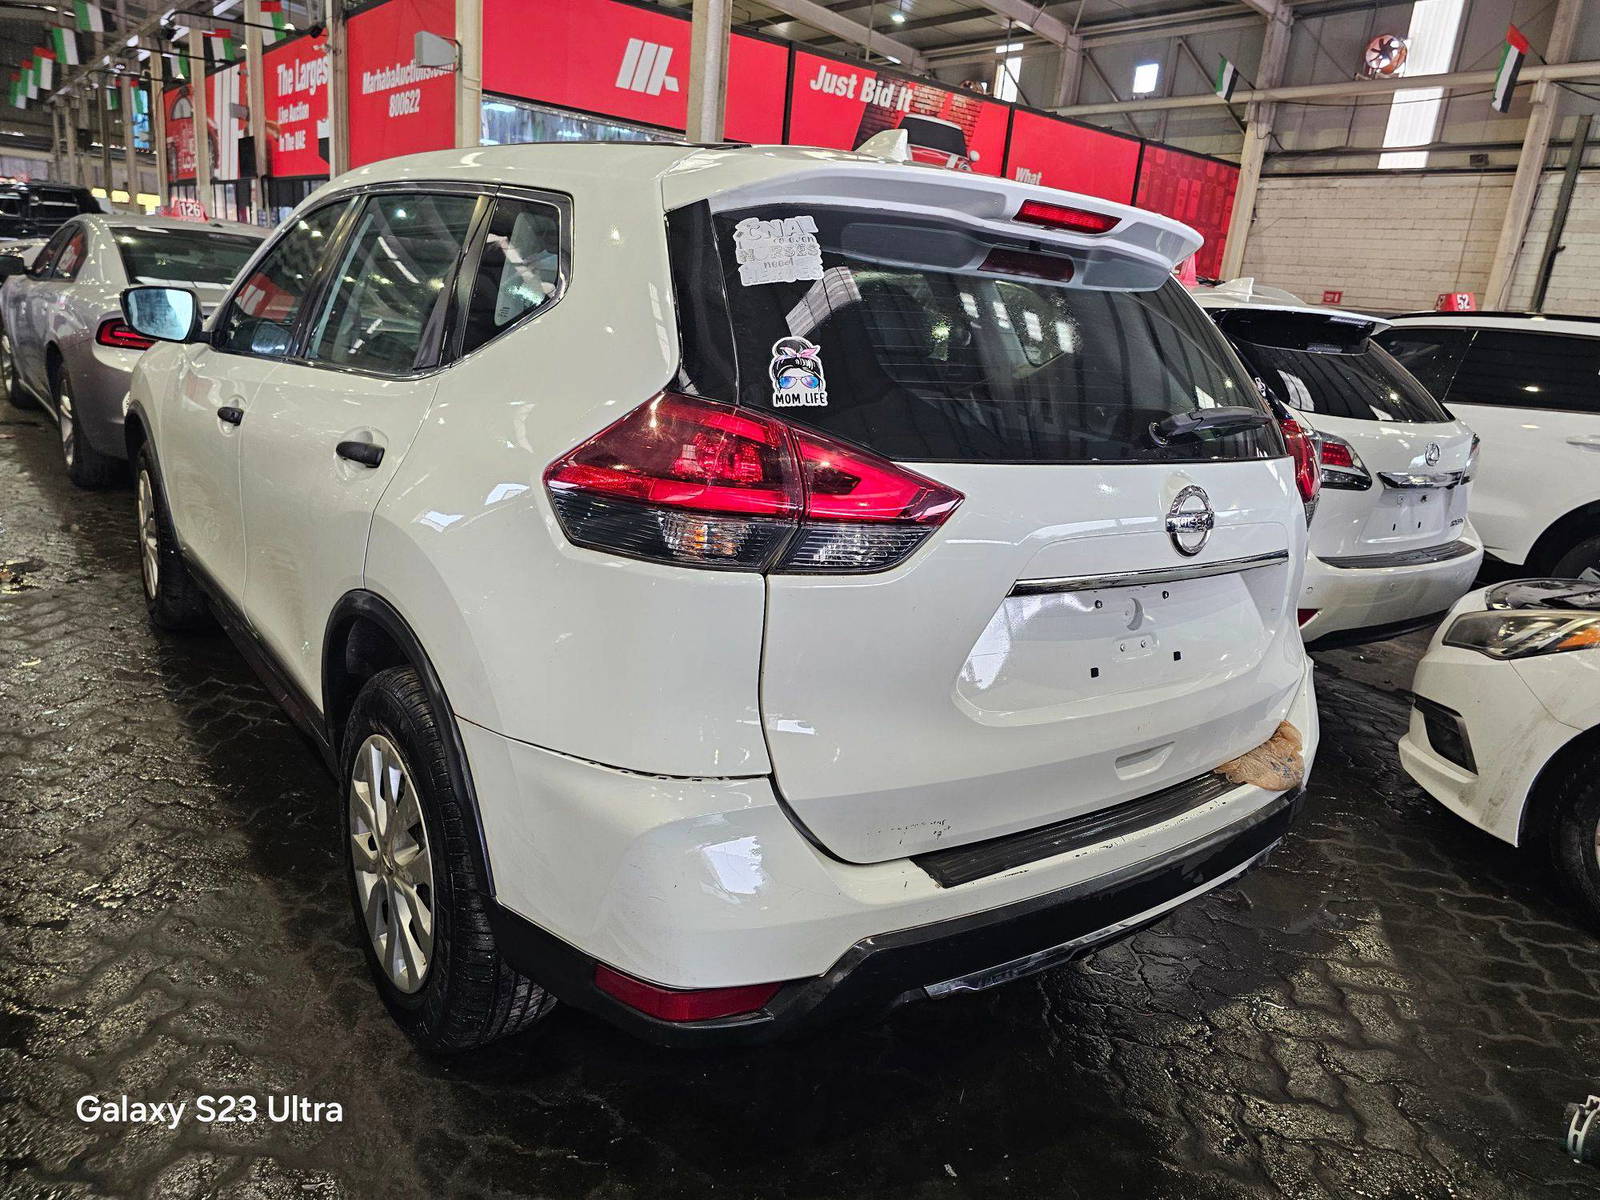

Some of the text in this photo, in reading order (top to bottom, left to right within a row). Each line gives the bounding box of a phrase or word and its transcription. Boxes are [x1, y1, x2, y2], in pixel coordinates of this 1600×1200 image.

[277, 63, 293, 96] The
[810, 65, 913, 112] Just Bid It
[289, 101, 309, 122] Auction
[389, 88, 421, 117] 800622
[284, 132, 295, 151] The
[295, 130, 306, 149] UAE
[1016, 167, 1043, 186] What
[180, 202, 200, 217] 126
[1457, 294, 1471, 310] 52
[775, 392, 826, 404] MOM LIFE
